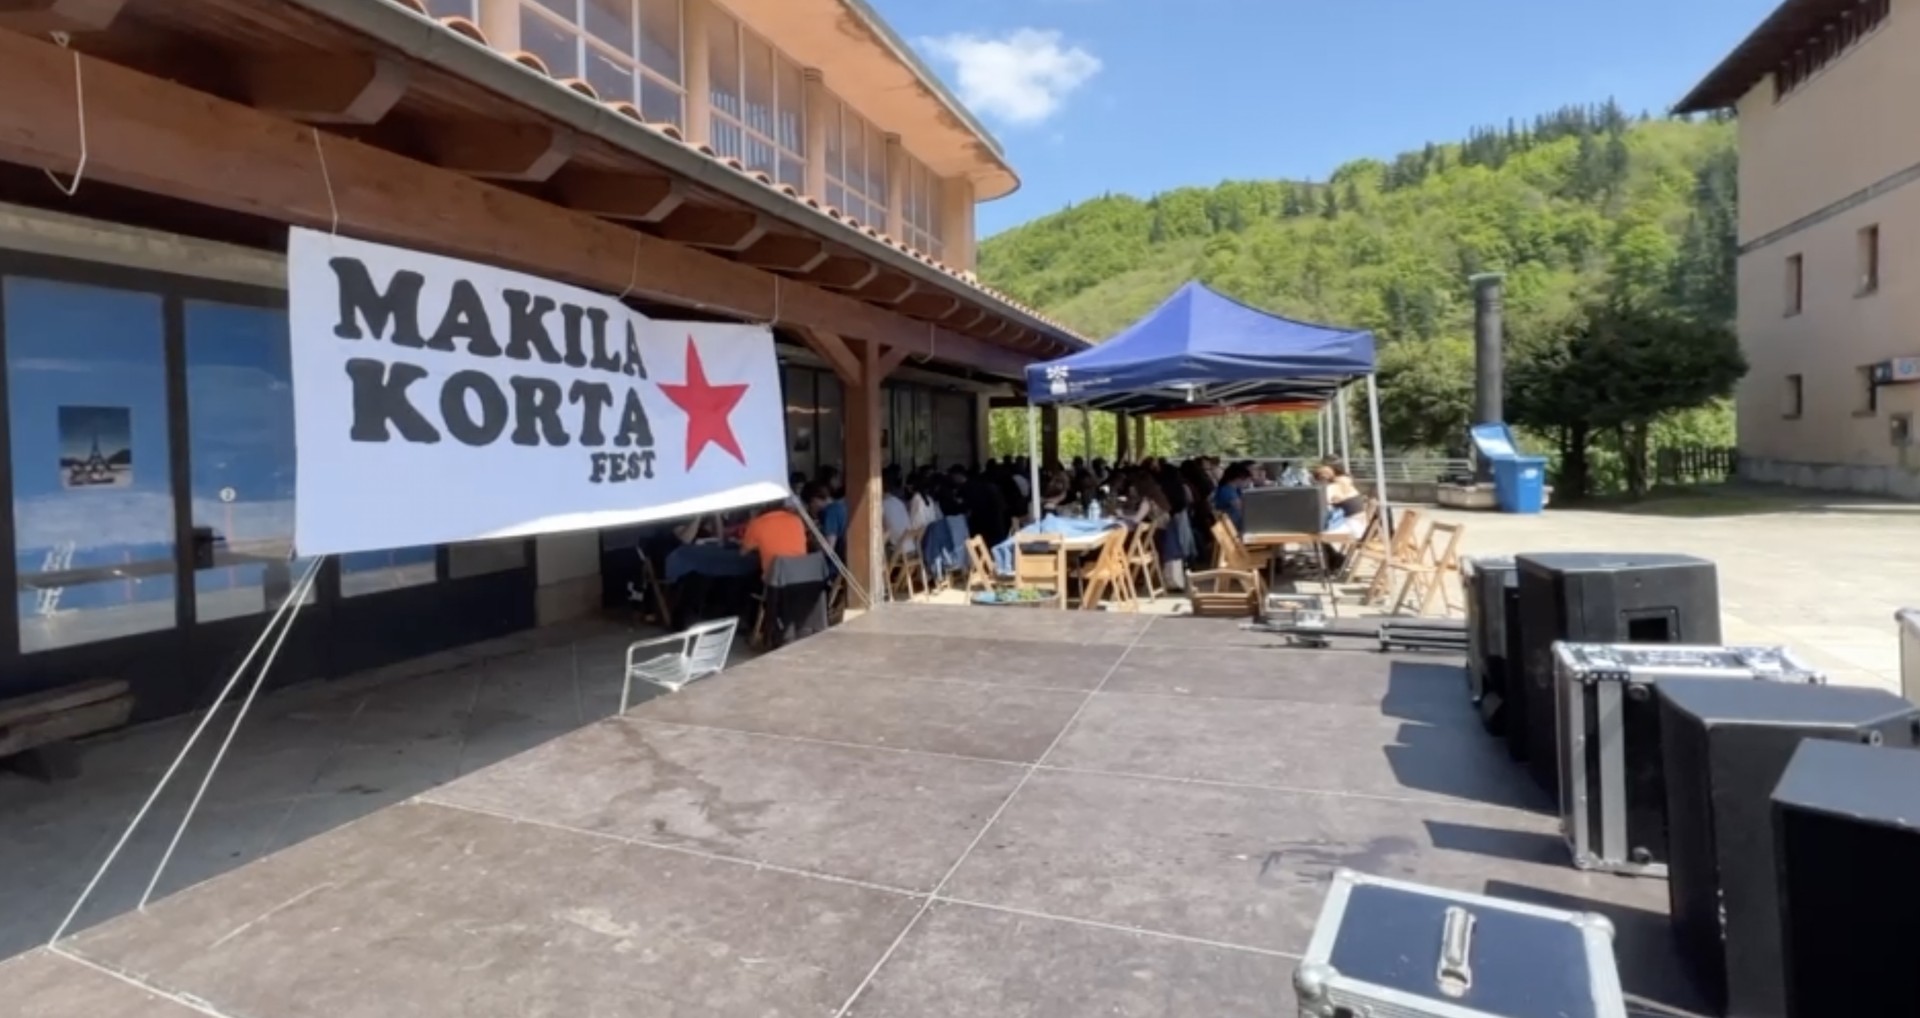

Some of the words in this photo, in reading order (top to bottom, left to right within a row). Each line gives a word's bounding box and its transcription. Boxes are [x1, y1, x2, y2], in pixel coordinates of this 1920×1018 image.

[329, 256, 648, 380] MAKILA
[345, 357, 654, 448] KORTA
[589, 450, 656, 484] FEST
